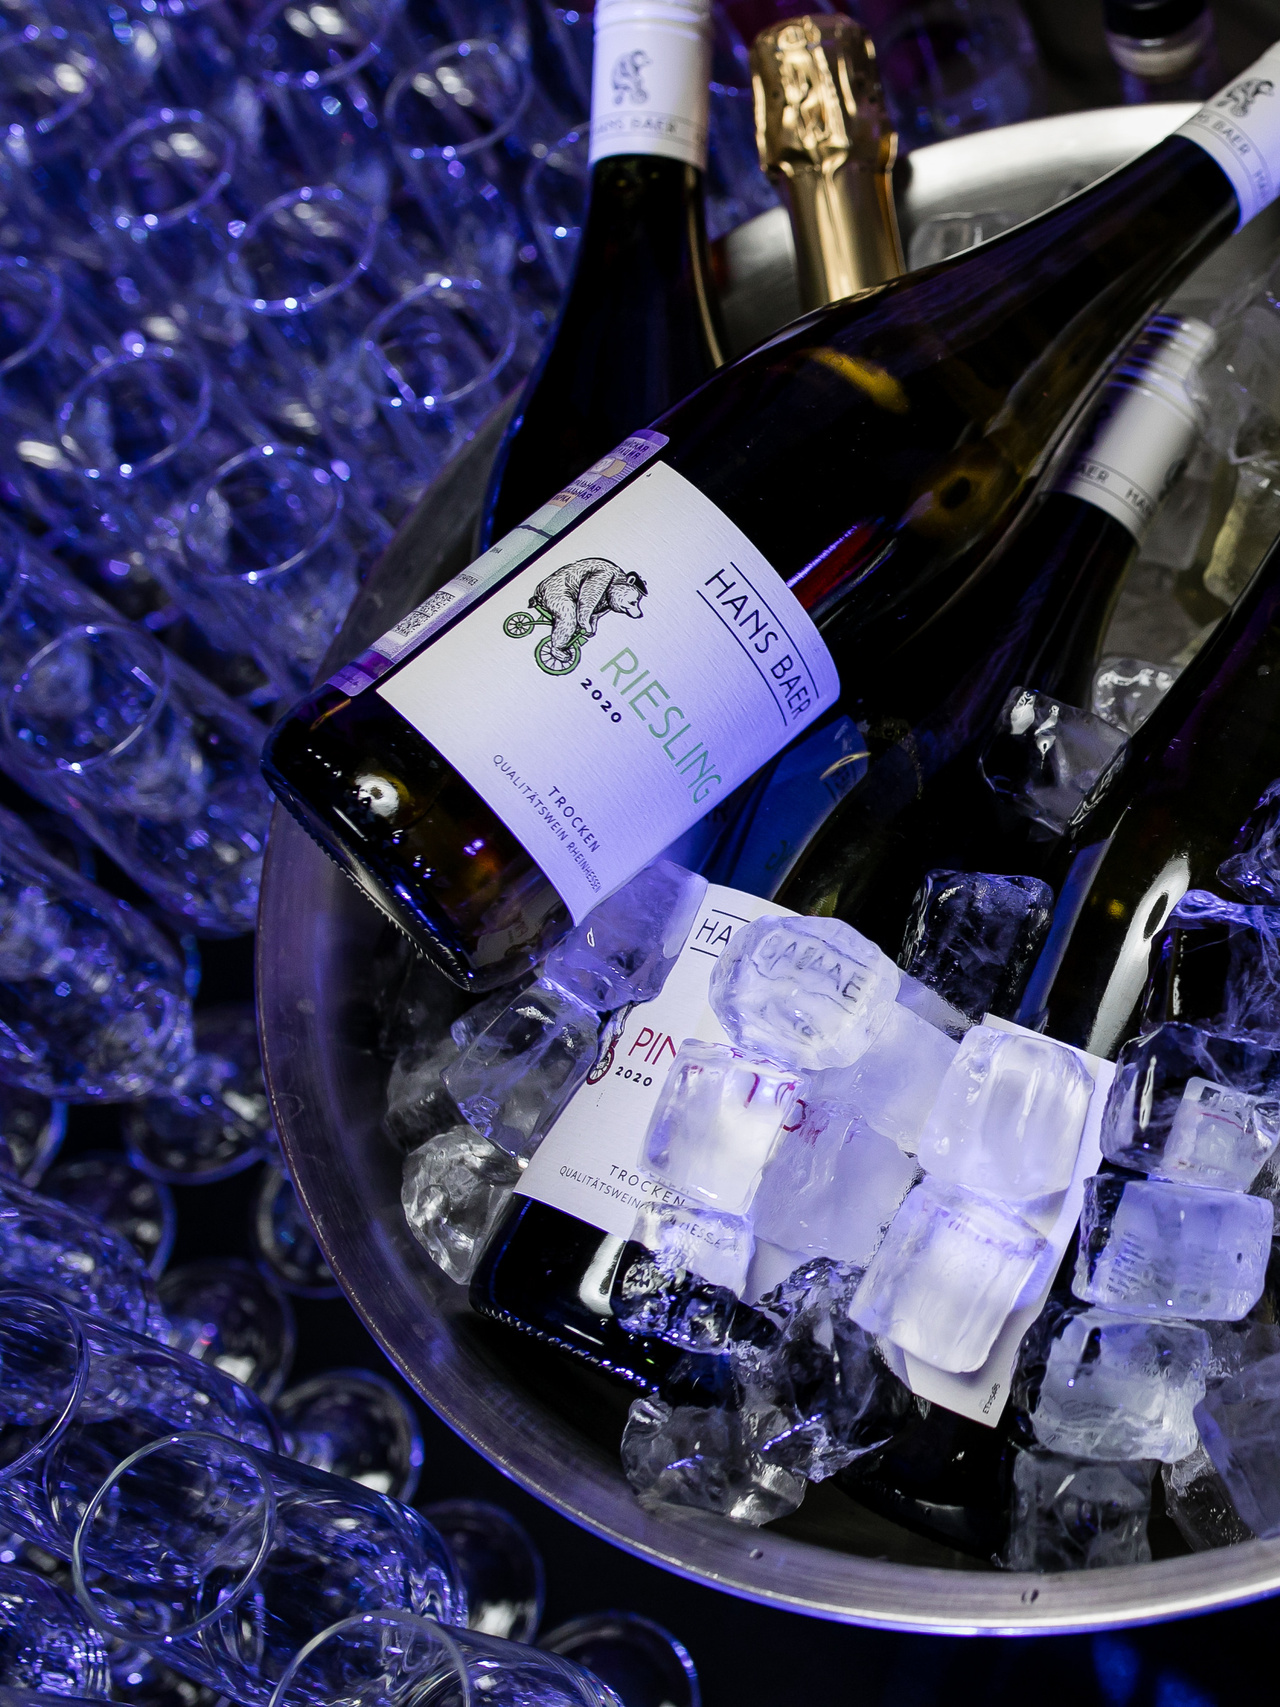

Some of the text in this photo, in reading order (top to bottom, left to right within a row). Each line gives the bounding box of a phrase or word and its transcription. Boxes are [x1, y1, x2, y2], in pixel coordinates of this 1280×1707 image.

[704, 568, 813, 720] HANS BAER
[579, 676, 623, 724] 2020
[599, 645, 722, 804] RIESLING
[493, 754, 569, 841] QUALITÄTSWEIN
[548, 785, 601, 853] TROCKEN
[694, 917, 733, 946] HA
[627, 1026, 678, 1066] PIN
[614, 1065, 654, 1088] 2020
[559, 1165, 641, 1210] QUALITÄTSWEIN
[609, 1164, 687, 1206] TROCKEN
